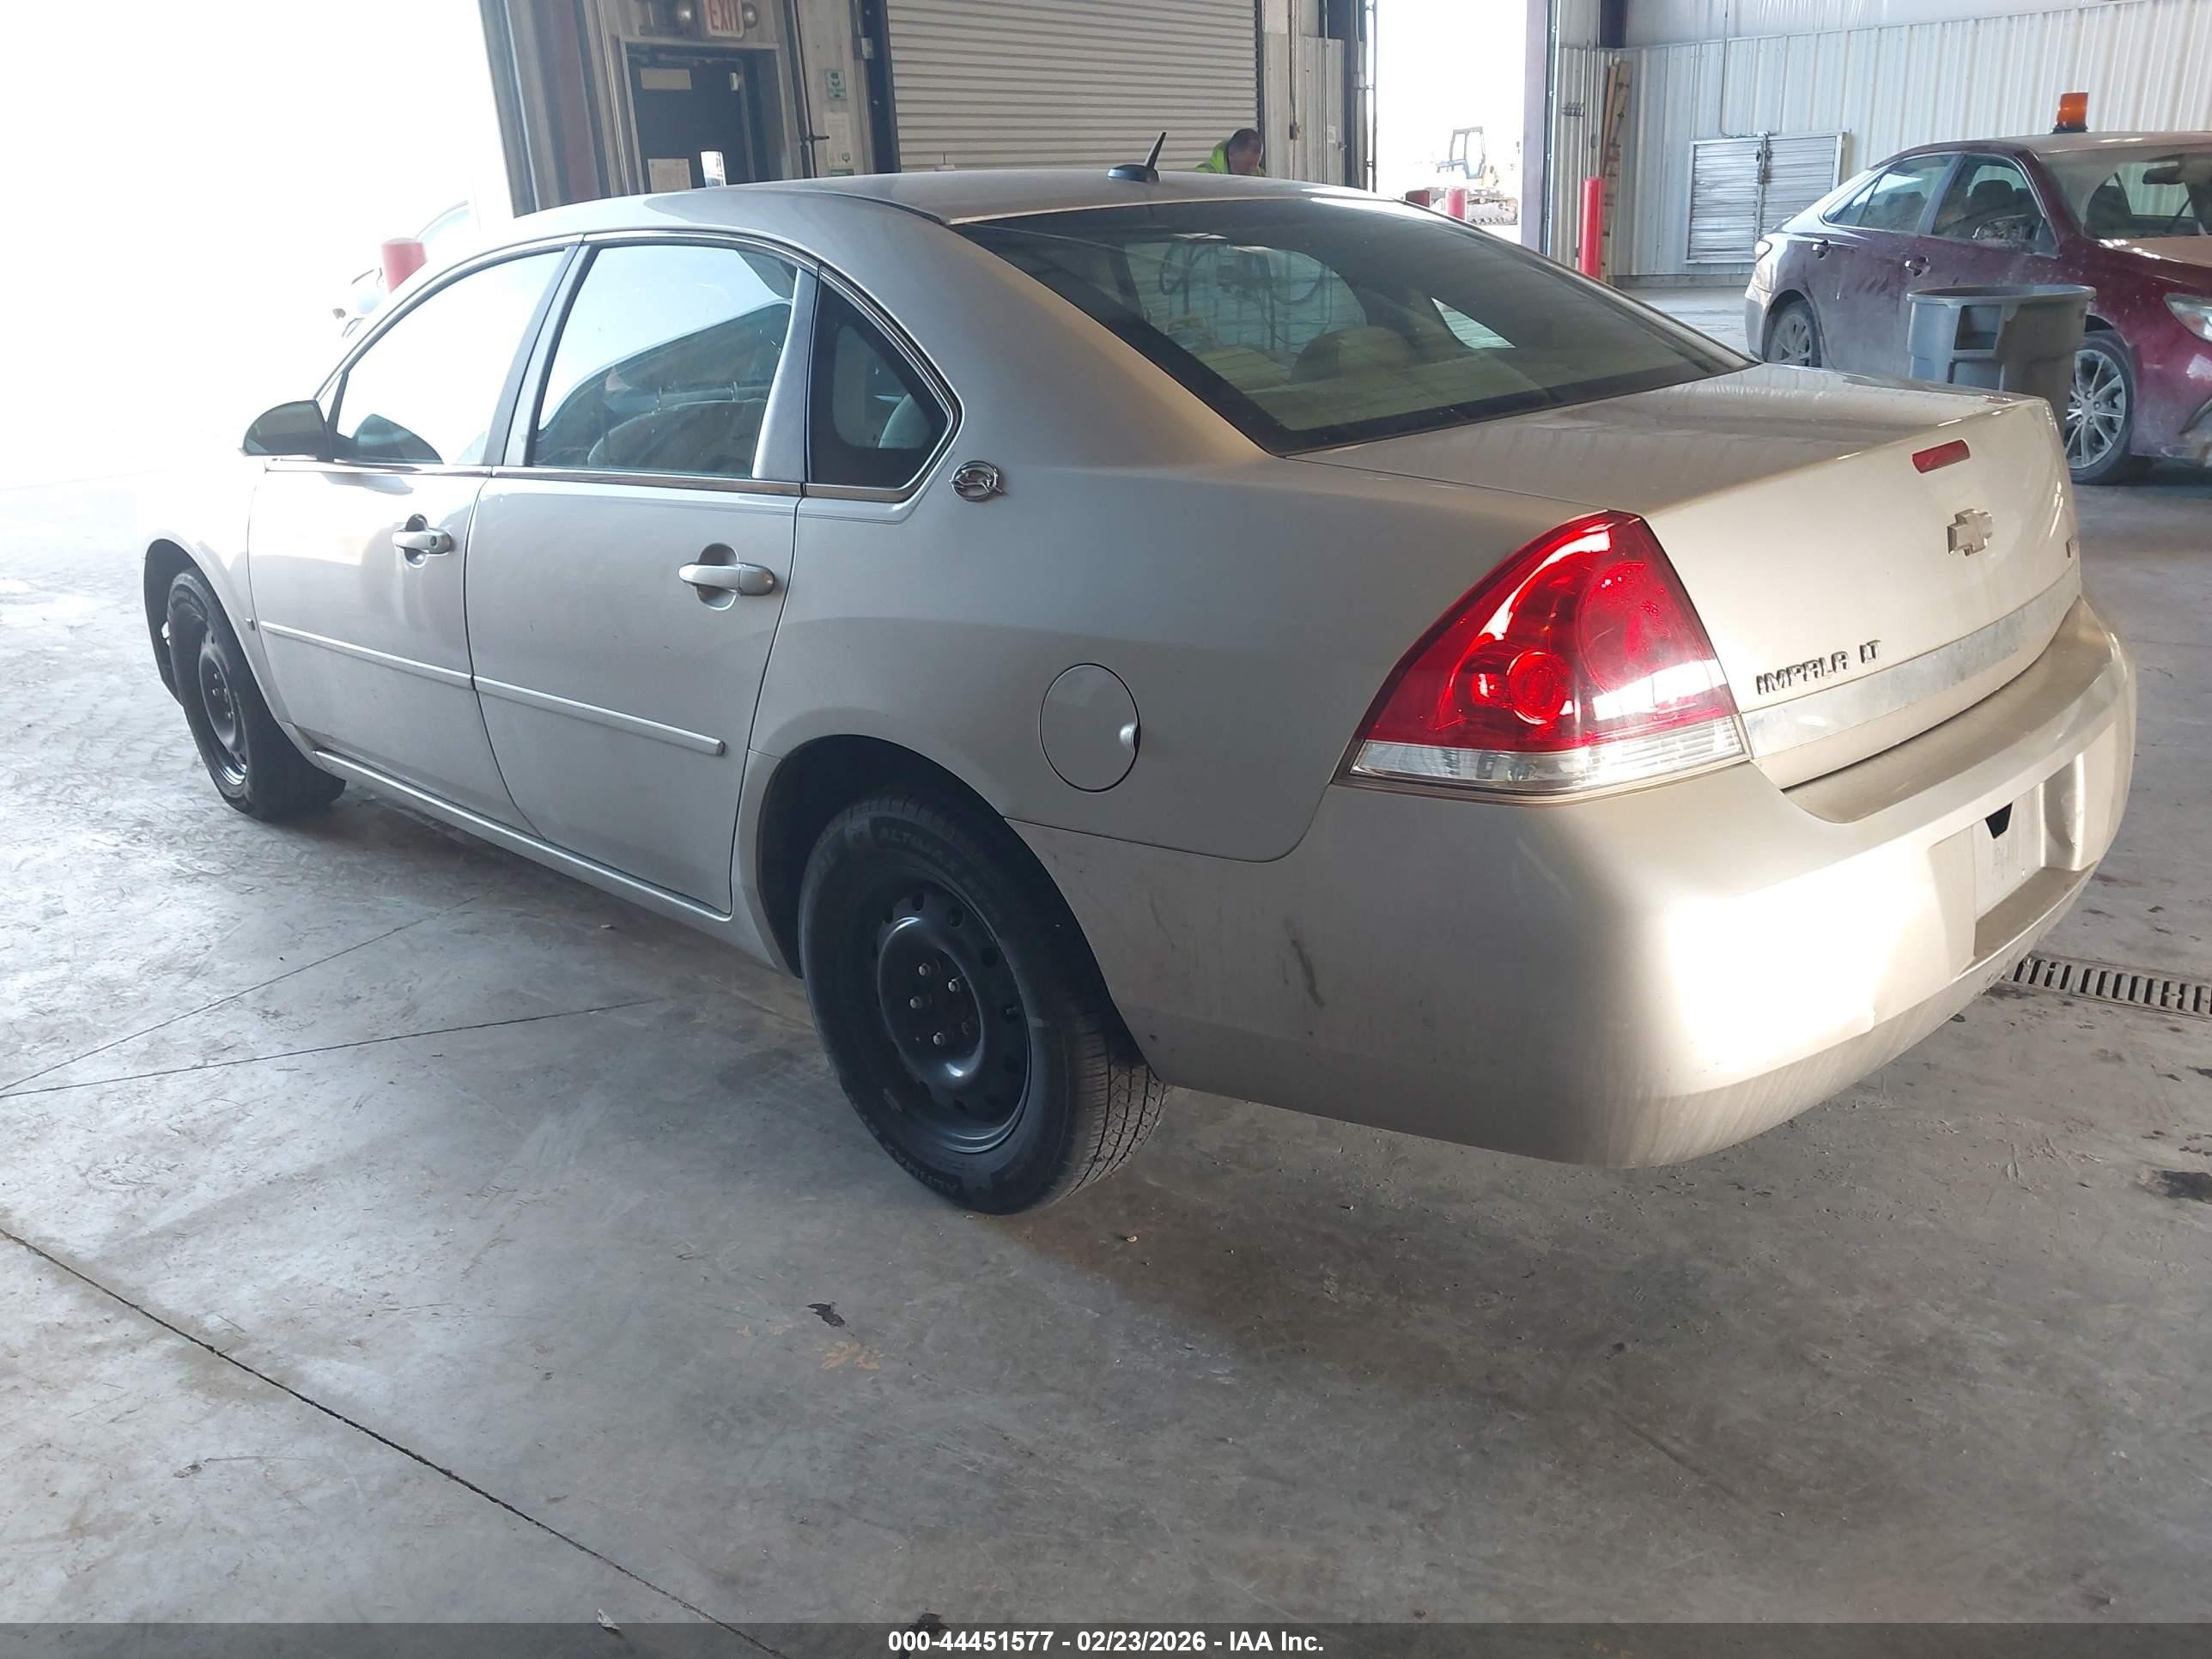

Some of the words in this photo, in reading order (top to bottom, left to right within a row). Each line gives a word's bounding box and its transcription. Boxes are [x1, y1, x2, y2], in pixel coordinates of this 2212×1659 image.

[708, 0, 741, 31] EXIT
[1756, 651, 1848, 695] IMPALA
[1859, 640, 1881, 664] LT
